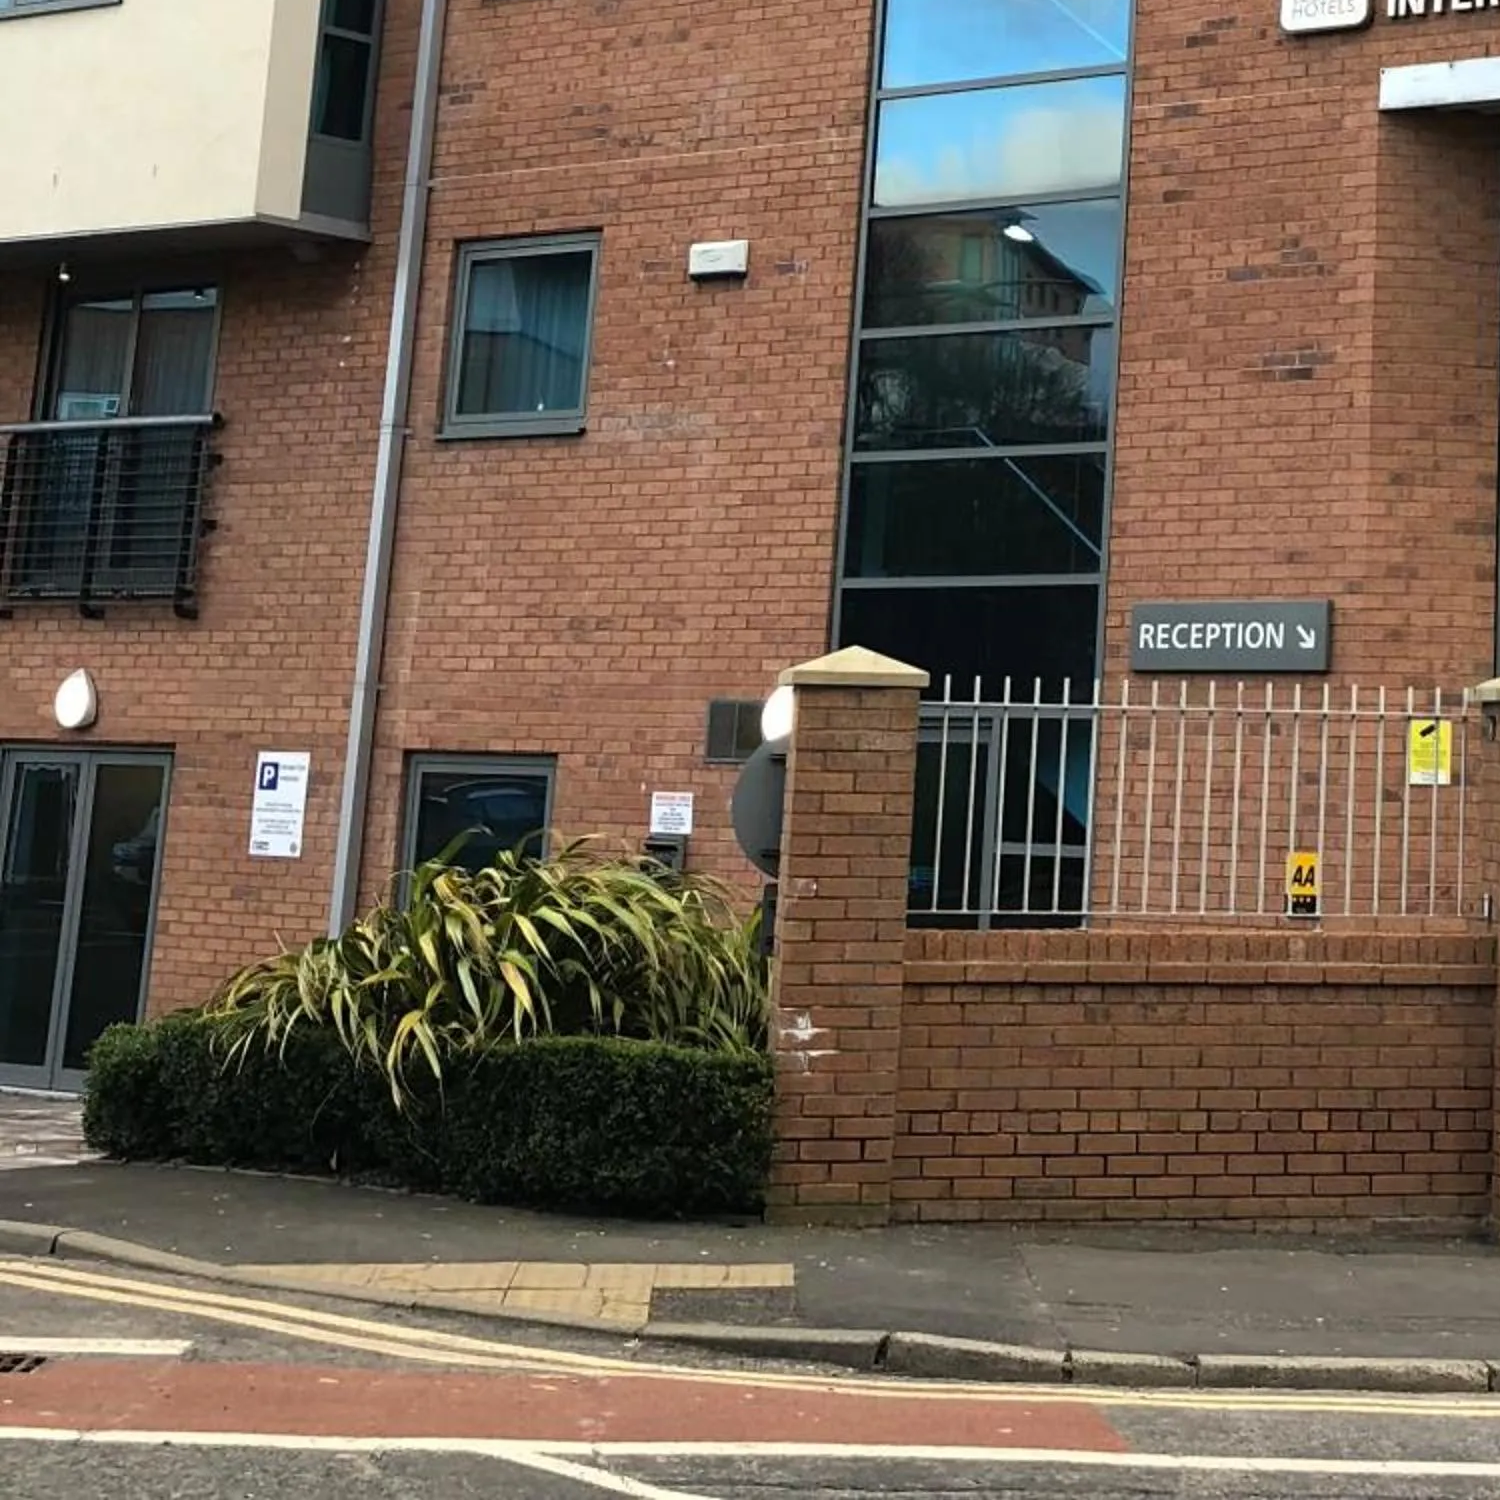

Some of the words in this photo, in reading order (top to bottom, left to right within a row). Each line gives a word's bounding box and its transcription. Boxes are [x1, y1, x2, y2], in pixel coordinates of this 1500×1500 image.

[1138, 621, 1285, 650] RECEPTION
[262, 765, 276, 788] P
[1292, 864, 1315, 887] AA
